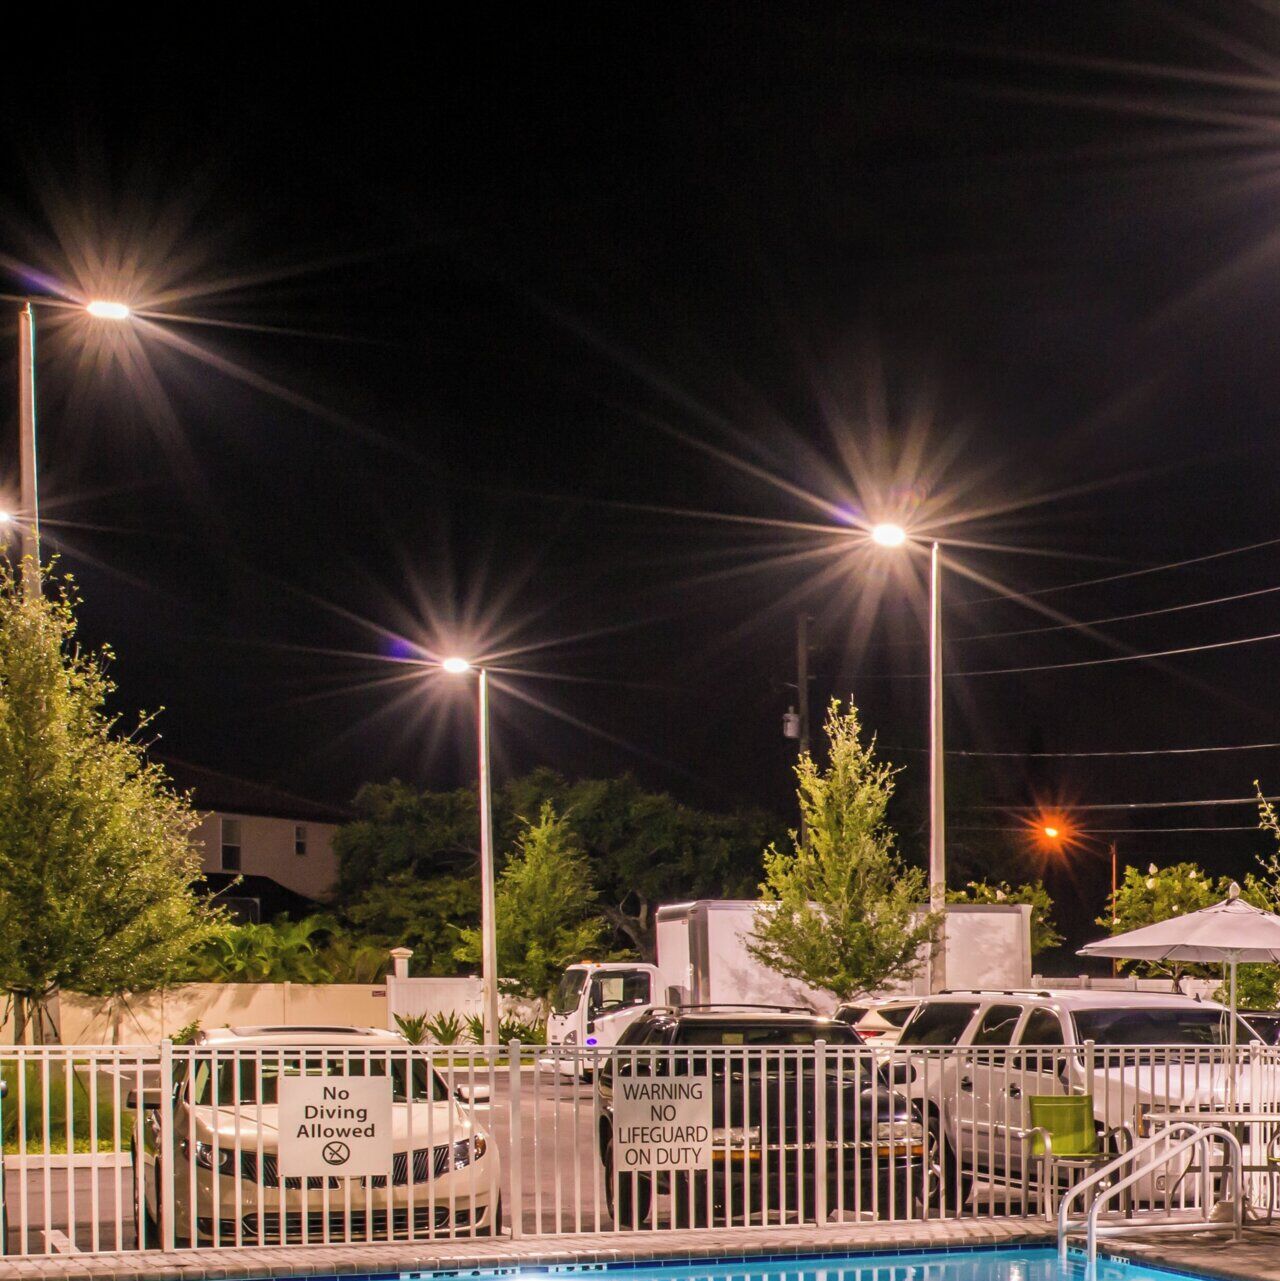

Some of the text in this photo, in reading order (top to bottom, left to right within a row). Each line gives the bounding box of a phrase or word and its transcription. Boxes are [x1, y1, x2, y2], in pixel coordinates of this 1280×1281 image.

[323, 1086, 349, 1100] No
[622, 1083, 703, 1100] WARNING
[304, 1105, 367, 1122] Diving
[651, 1104, 676, 1122] NO
[296, 1123, 375, 1138] Allowed
[618, 1125, 709, 1143] LIFEGUARD
[625, 1147, 702, 1165] ON DUTY
